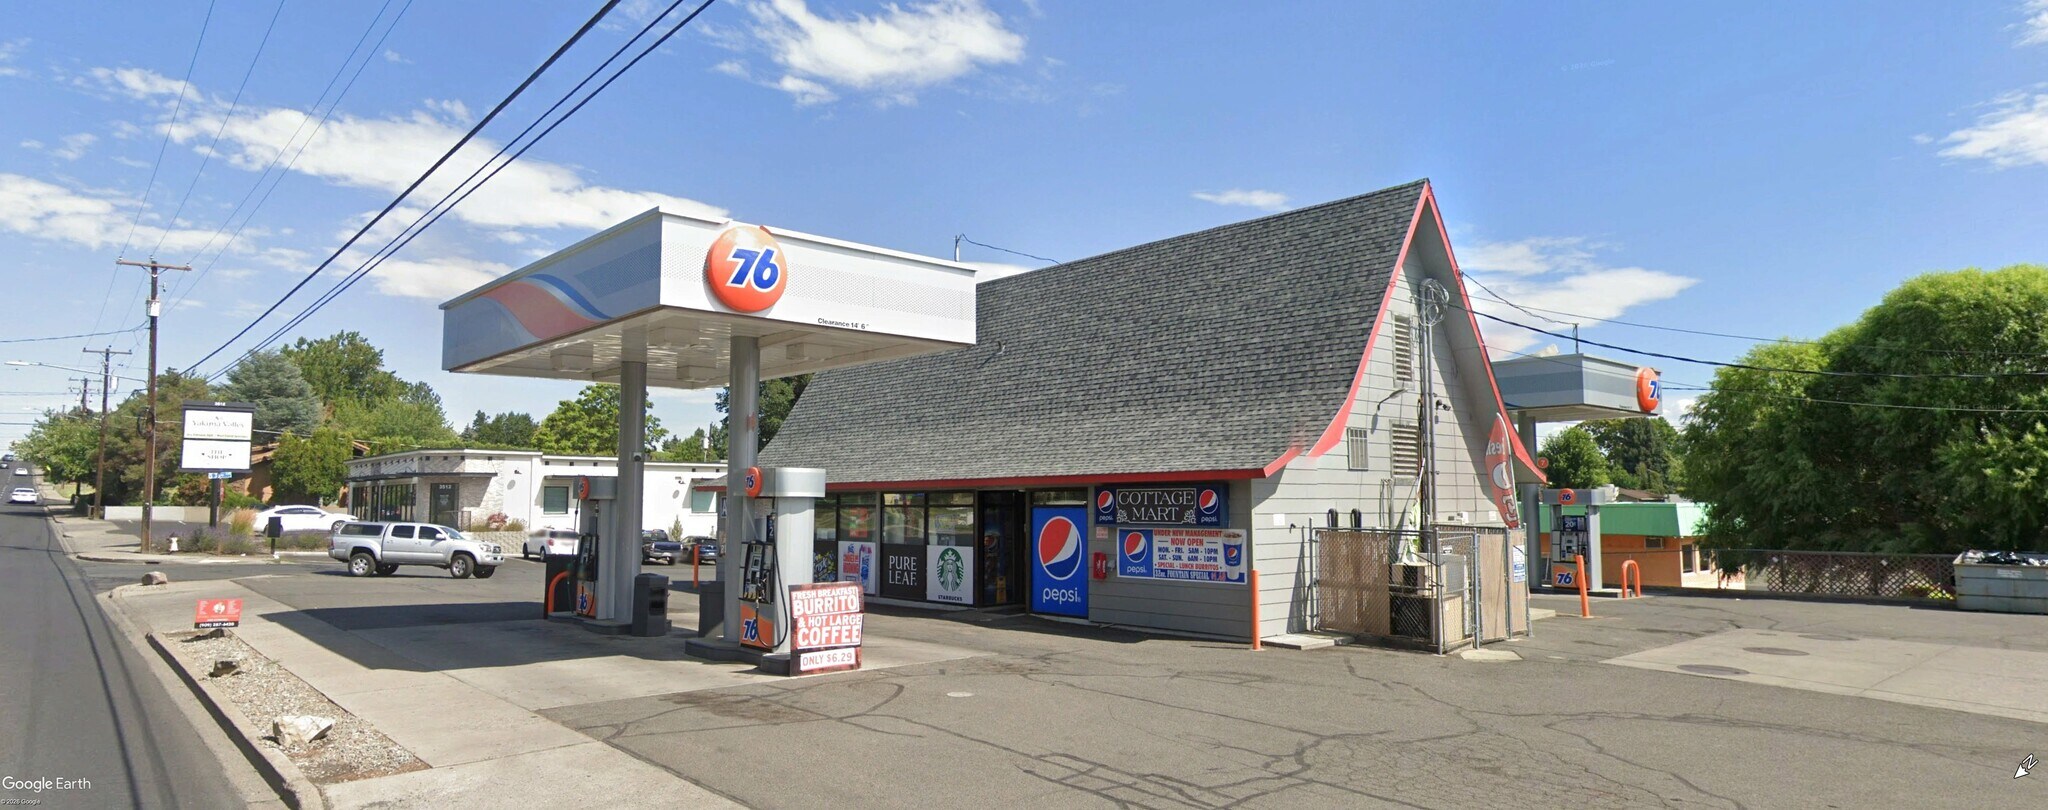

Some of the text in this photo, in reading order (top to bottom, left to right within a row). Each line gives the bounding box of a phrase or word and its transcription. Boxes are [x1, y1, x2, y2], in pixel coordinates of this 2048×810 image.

[726, 245, 781, 292] 76
[817, 317, 850, 328] Clearance
[745, 474, 755, 490] 76
[1118, 491, 1194, 506] COTTAGE
[1562, 493, 1571, 501] 76
[1132, 506, 1180, 521] MART
[1200, 515, 1218, 523] pepsi
[1153, 529, 1222, 538] UNDER NEW MANAGEMENT
[1170, 537, 1204, 547] NOW OPEN
[889, 555, 917, 571] PURE
[1203, 555, 1218, 563] 10PM
[1126, 565, 1147, 574] pepsi
[1157, 561, 1176, 569] SPECIAL
[1195, 563, 1219, 571] BURRITOS
[1167, 569, 1189, 579] FOUNTAIN
[1190, 570, 1210, 580] SPECIAL
[1556, 572, 1573, 584] 76
[792, 587, 857, 600] FRESH BREAKFAST
[938, 594, 963, 602] STARBUCKS
[1042, 587, 1078, 604] pepsi
[578, 594, 588, 611] 76
[793, 595, 857, 616] BURRITO
[797, 614, 862, 628] & HOT LARGE
[743, 618, 758, 642] 76
[797, 625, 861, 646] COFFEE
[802, 652, 853, 666] ONLY $6.29
